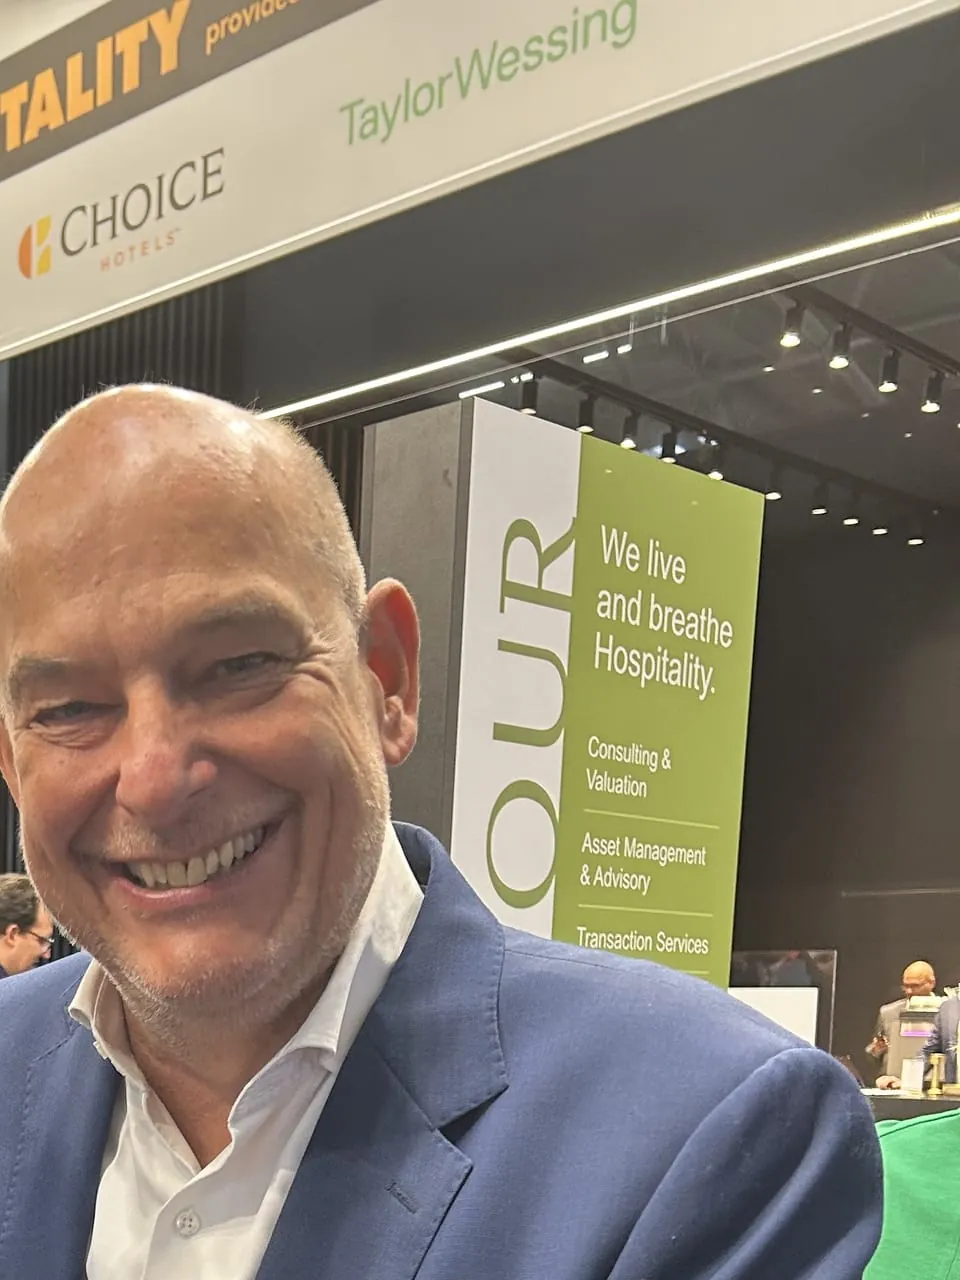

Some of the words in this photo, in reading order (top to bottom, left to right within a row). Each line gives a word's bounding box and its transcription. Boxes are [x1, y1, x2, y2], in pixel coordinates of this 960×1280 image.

[206, 0, 302, 55] provide
[340, 0, 638, 146] TaylorWessing
[60, 147, 225, 257] CHOICE
[100, 230, 178, 272] HOTELS
[600, 524, 640, 572] We
[647, 539, 687, 584] live
[596, 589, 642, 627] and
[648, 592, 733, 649] breathe
[594, 631, 716, 701] Hospitality.
[486, 517, 576, 909] OUR
[588, 735, 658, 773] Consulting
[661, 748, 672, 770] &
[586, 768, 648, 798] Valuation
[581, 831, 621, 857] Asset
[624, 836, 707, 867] Management
[579, 863, 590, 886] &
[593, 865, 652, 897] Advisory
[577, 926, 653, 952] Transaction
[656, 930, 709, 955] Services
